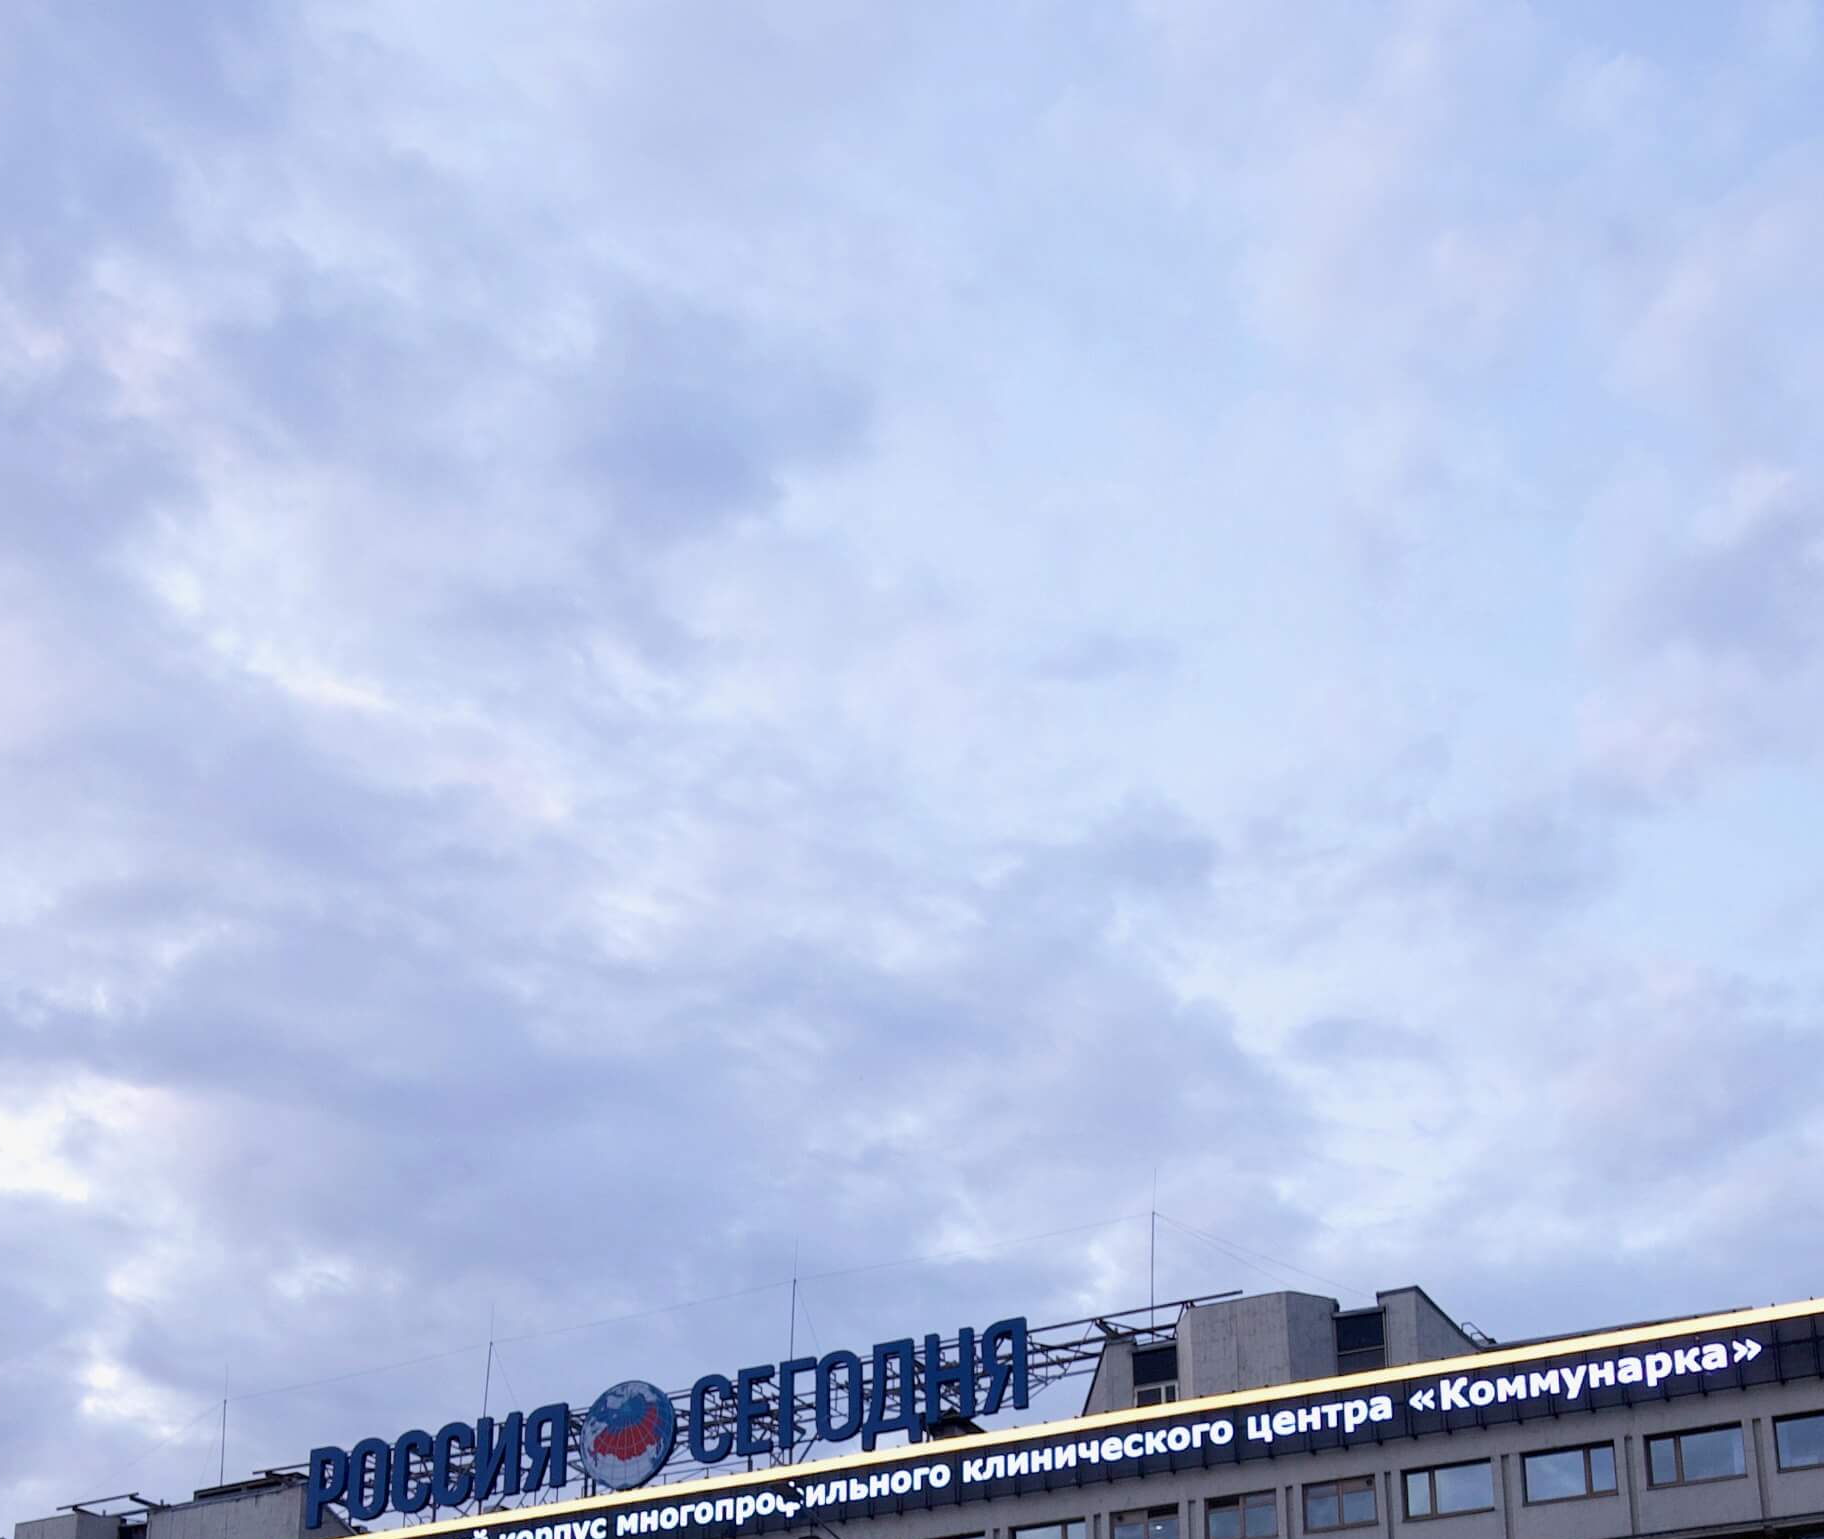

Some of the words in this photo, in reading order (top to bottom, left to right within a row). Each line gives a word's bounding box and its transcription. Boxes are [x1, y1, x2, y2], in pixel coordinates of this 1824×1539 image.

[305, 1402, 570, 1529] РОССИЯ
[687, 1316, 1029, 1464] СЕГОДНЯ
[962, 1417, 1233, 1483] клинического
[1246, 1395, 1394, 1444] центра
[1408, 1338, 1763, 1414] «Коммунарка»
